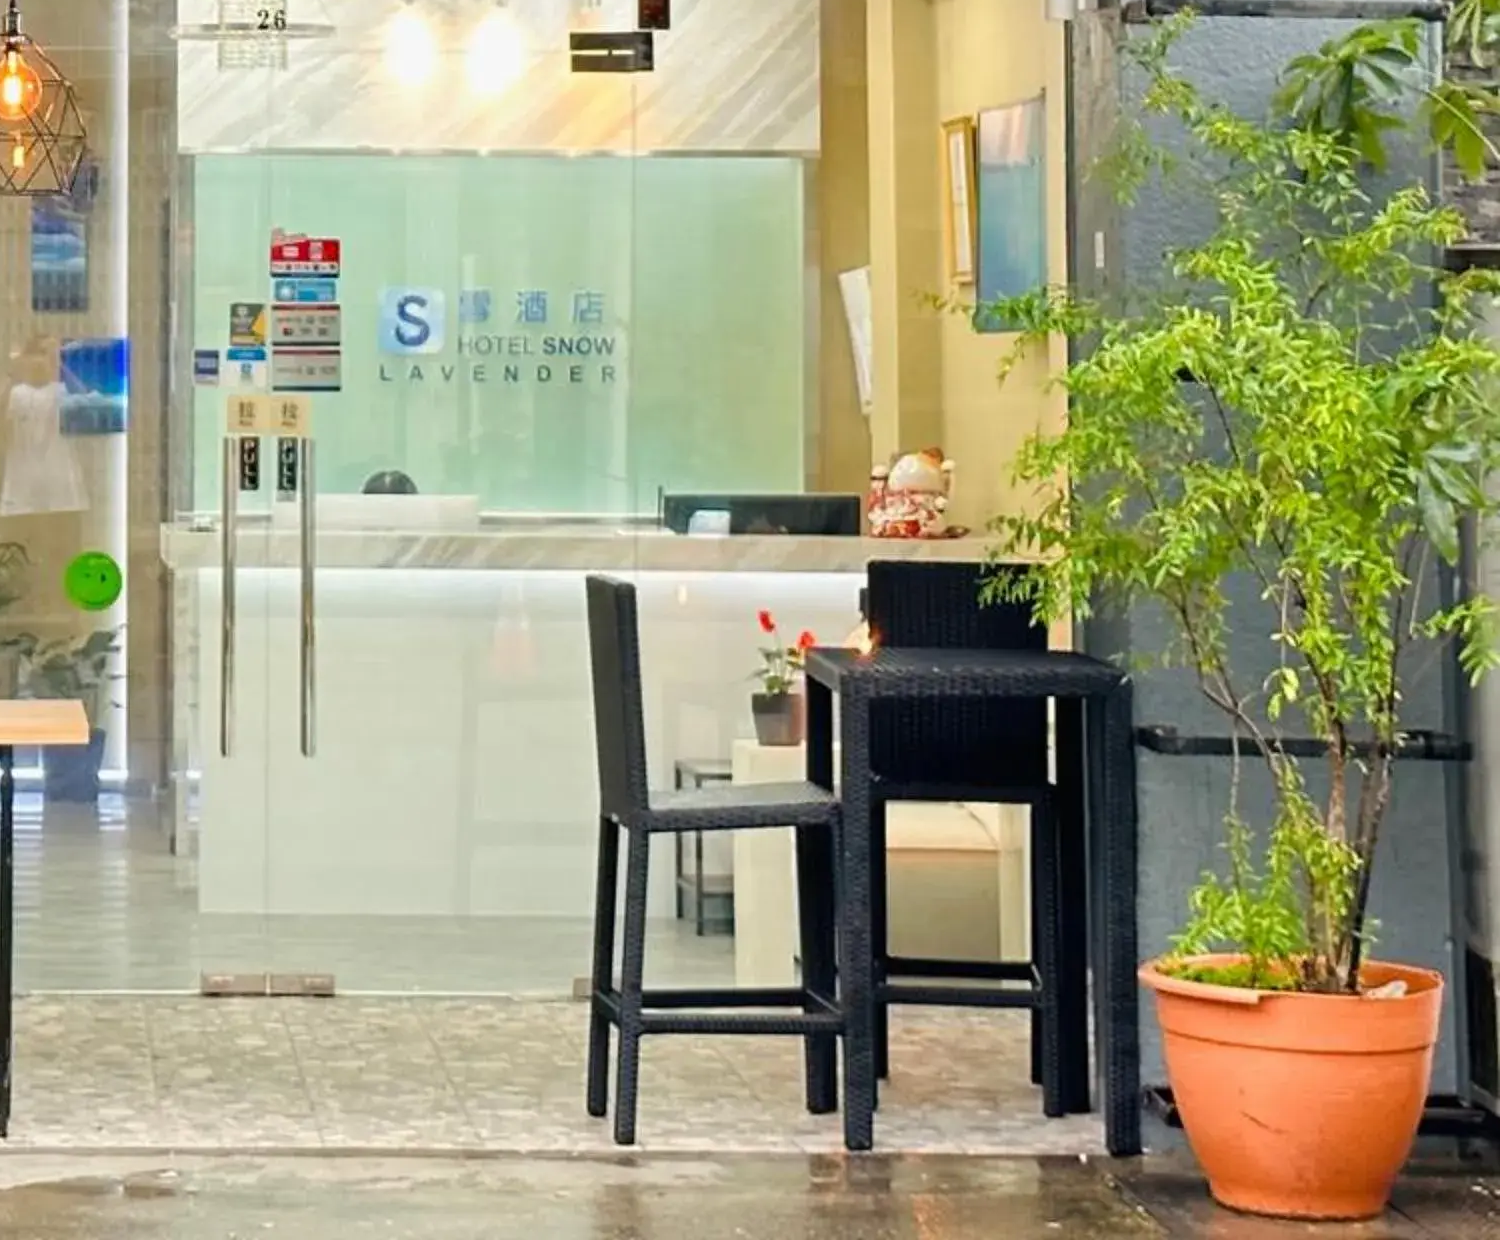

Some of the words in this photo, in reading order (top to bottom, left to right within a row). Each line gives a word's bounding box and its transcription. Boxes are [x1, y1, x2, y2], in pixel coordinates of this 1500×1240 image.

[257, 9, 287, 31] 26
[394, 295, 430, 347] S
[457, 335, 535, 356] HOTEL
[541, 336, 617, 356] SNOW
[378, 364, 617, 383] LAVENDER
